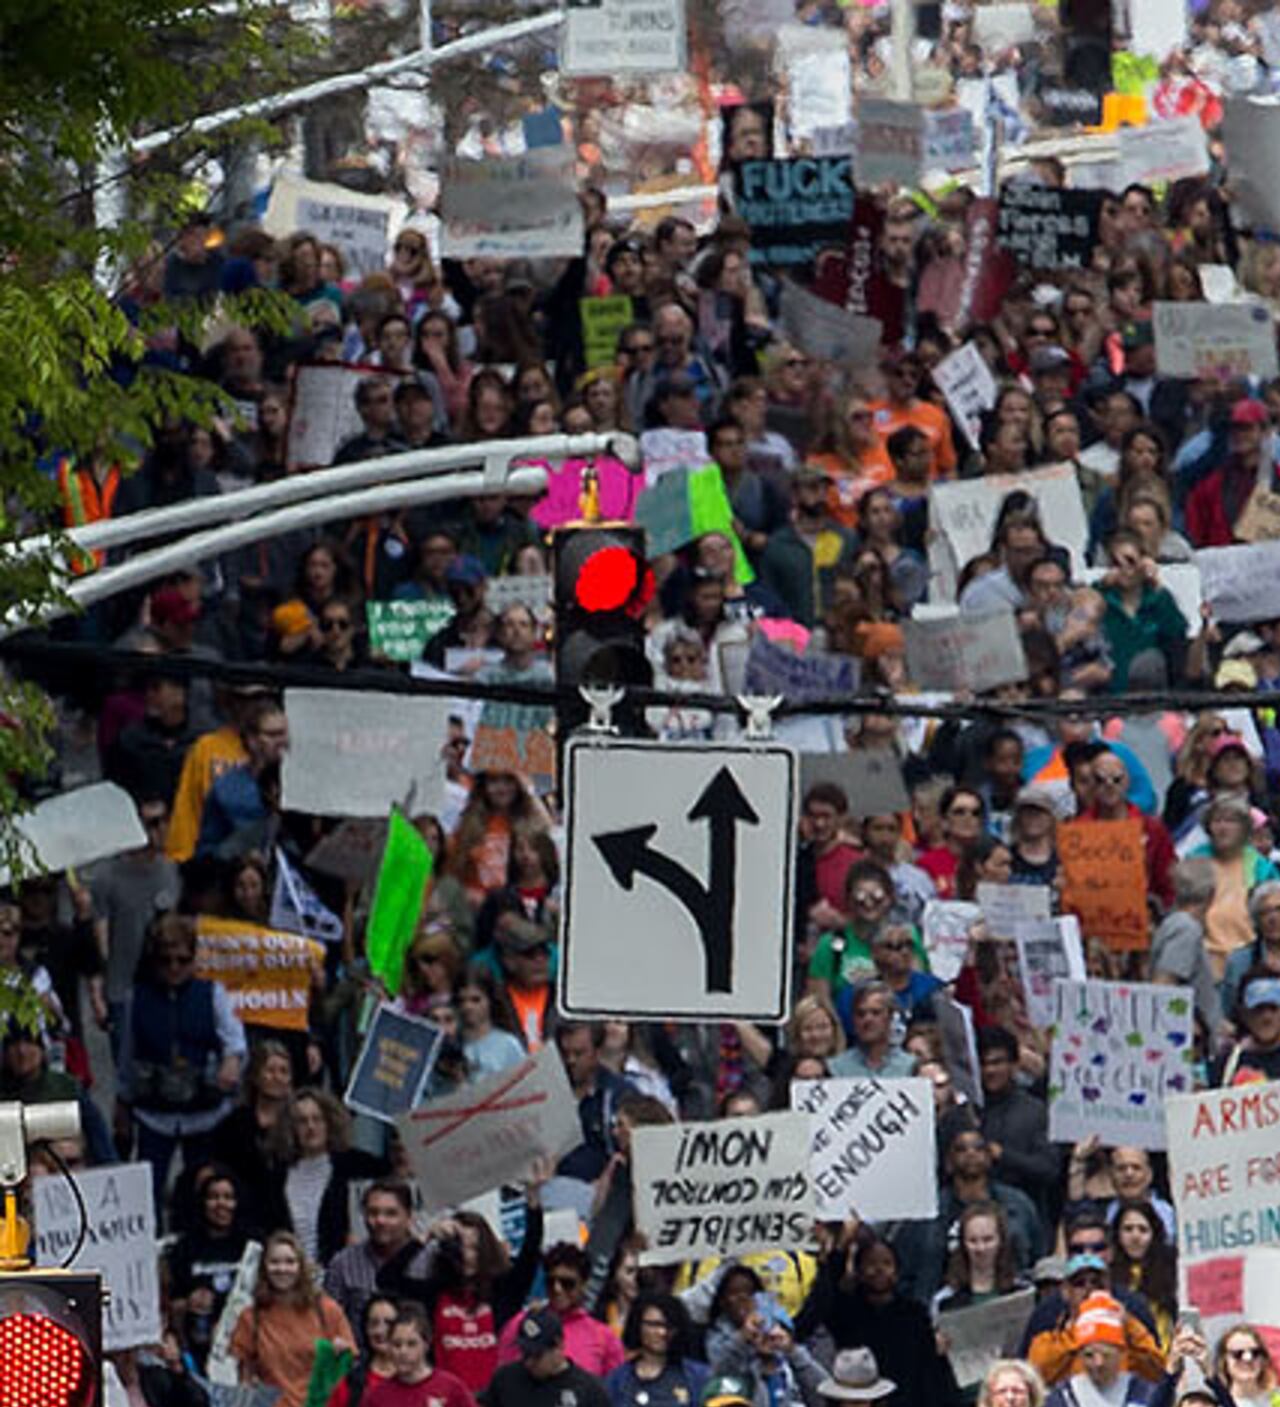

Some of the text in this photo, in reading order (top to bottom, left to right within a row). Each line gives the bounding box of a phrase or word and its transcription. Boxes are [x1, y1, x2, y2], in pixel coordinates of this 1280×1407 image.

[742, 161, 851, 194] FUCK
[675, 1129, 773, 1173] NOW!
[815, 1092, 921, 1200] ENOUGH
[1184, 1171, 1239, 1199] ARE
[656, 1213, 807, 1252] SENSIBLE
